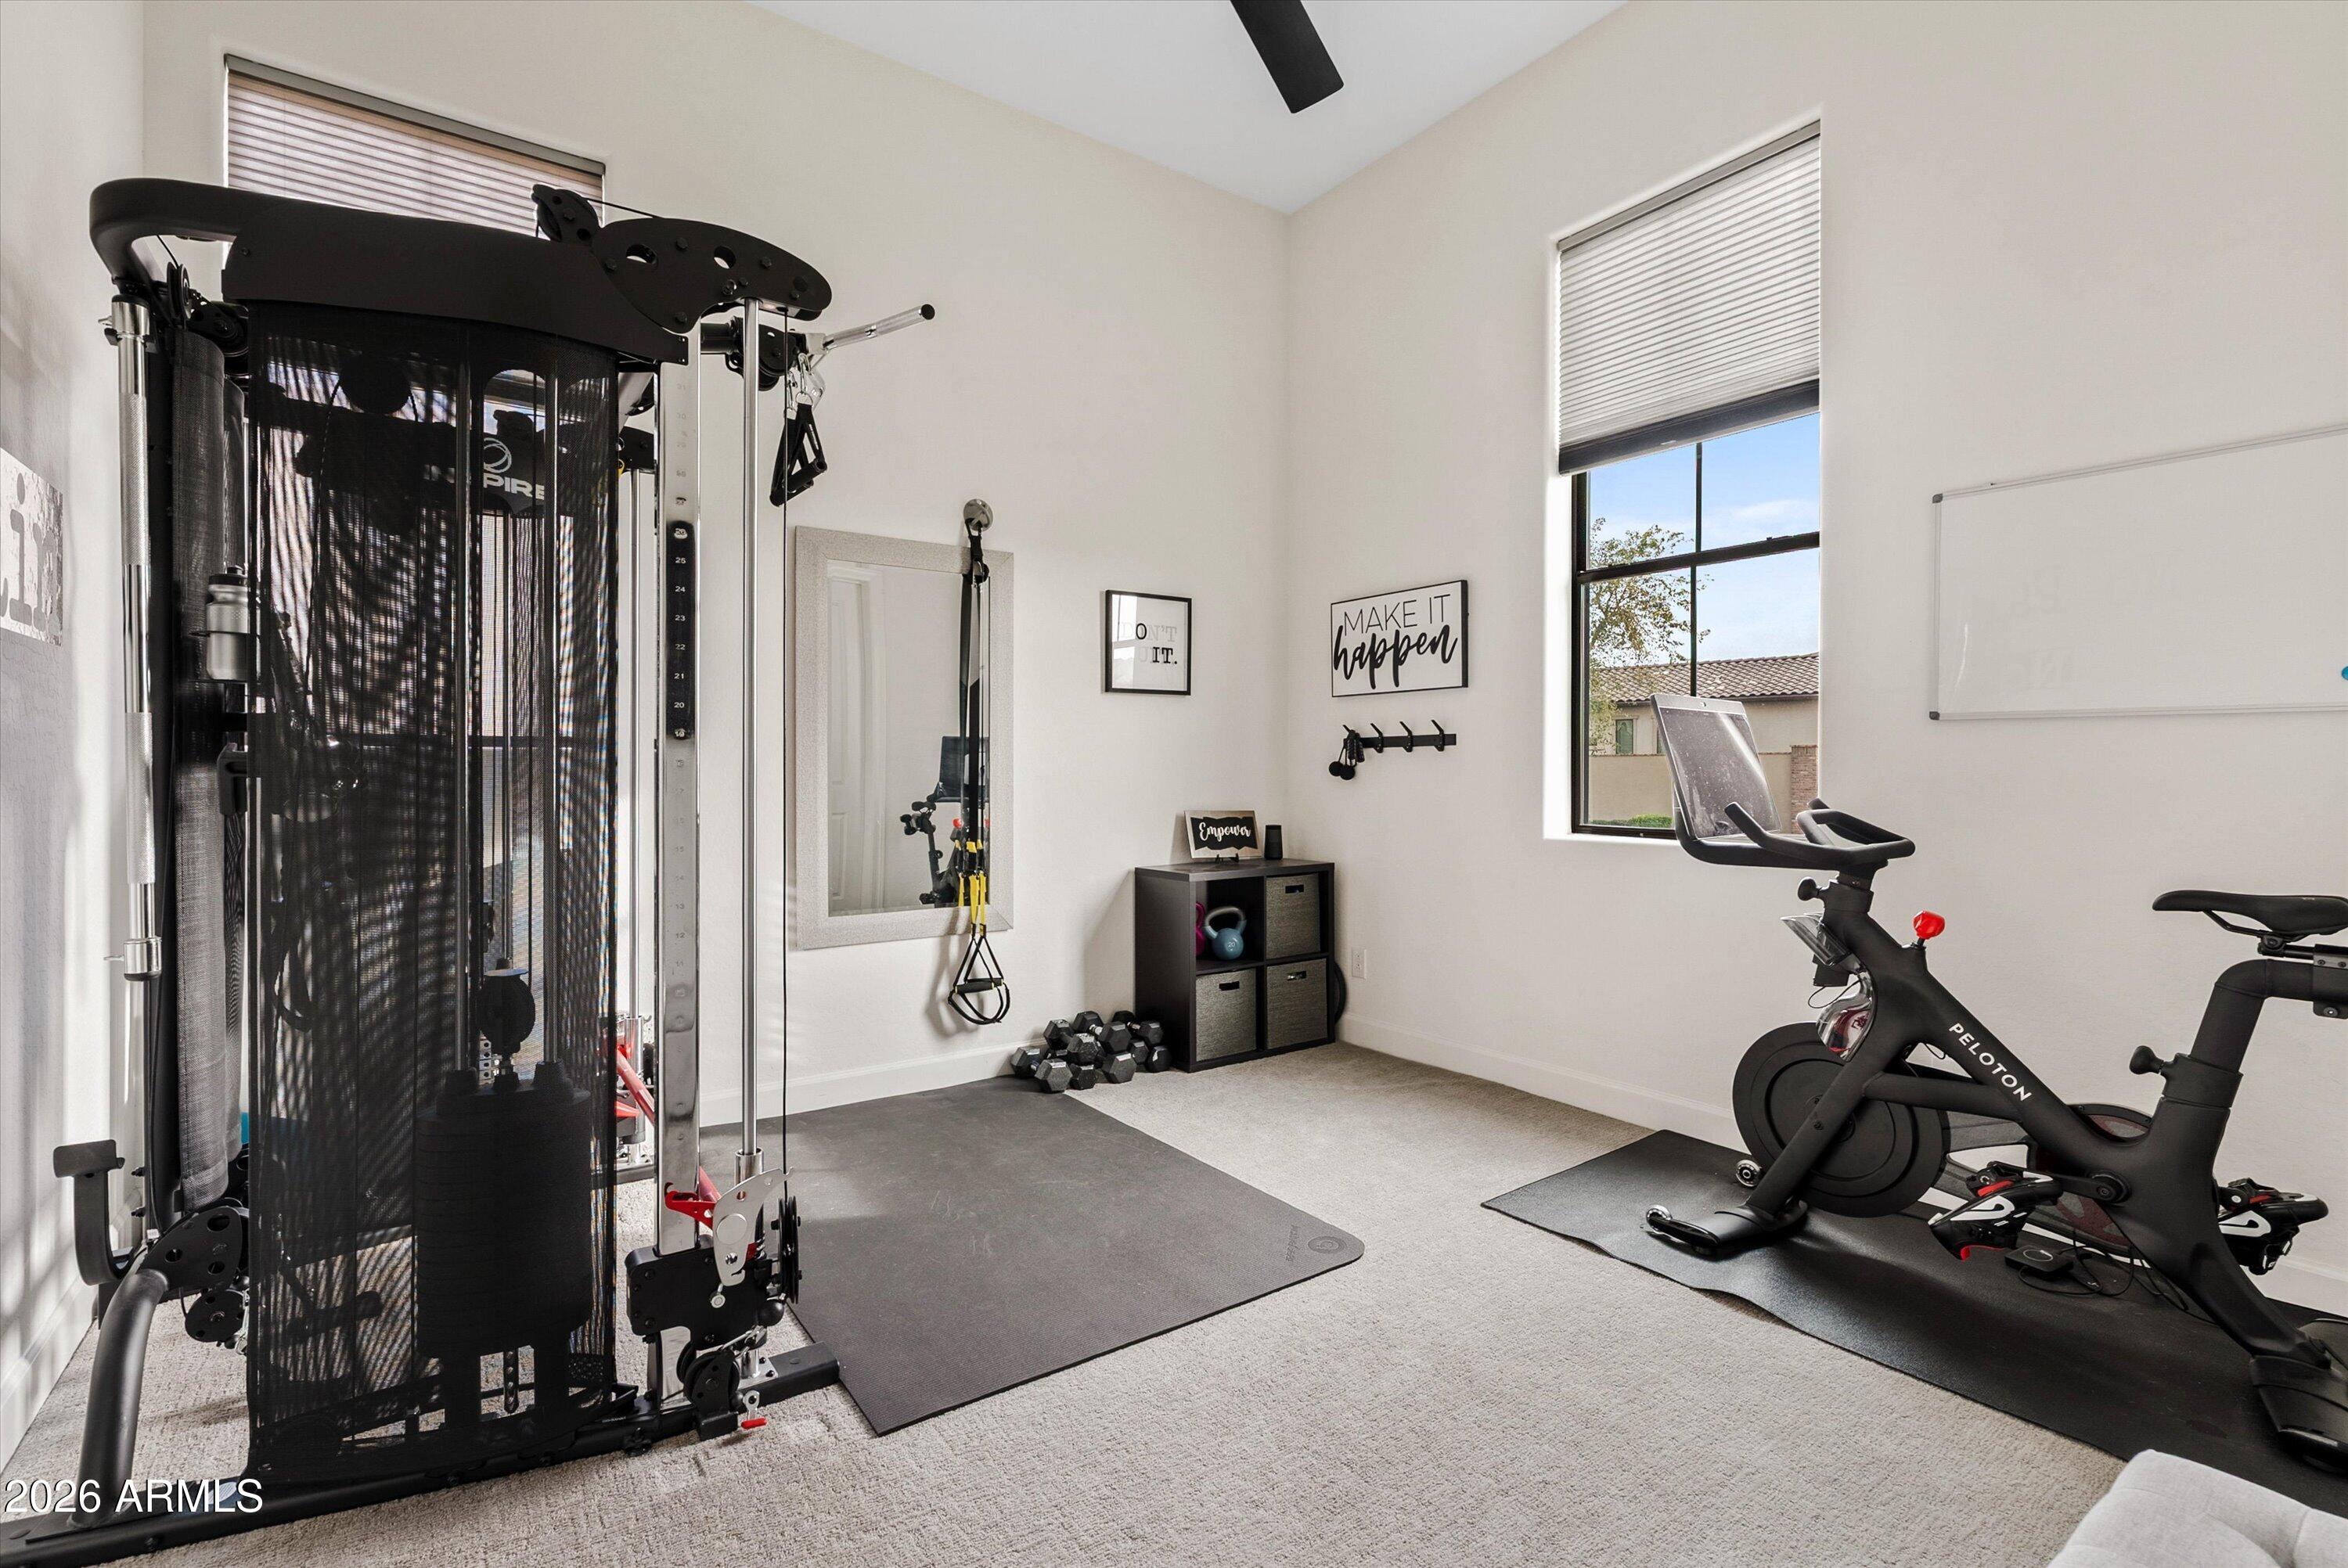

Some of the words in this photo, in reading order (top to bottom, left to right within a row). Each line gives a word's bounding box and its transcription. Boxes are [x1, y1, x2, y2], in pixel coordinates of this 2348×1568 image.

[1344, 599, 1418, 637] MAKE
[1428, 593, 1451, 624] IT
[1333, 624, 1458, 690] happen
[1198, 822, 1251, 843] Empower
[1948, 1023, 2033, 1102] PELOTON
